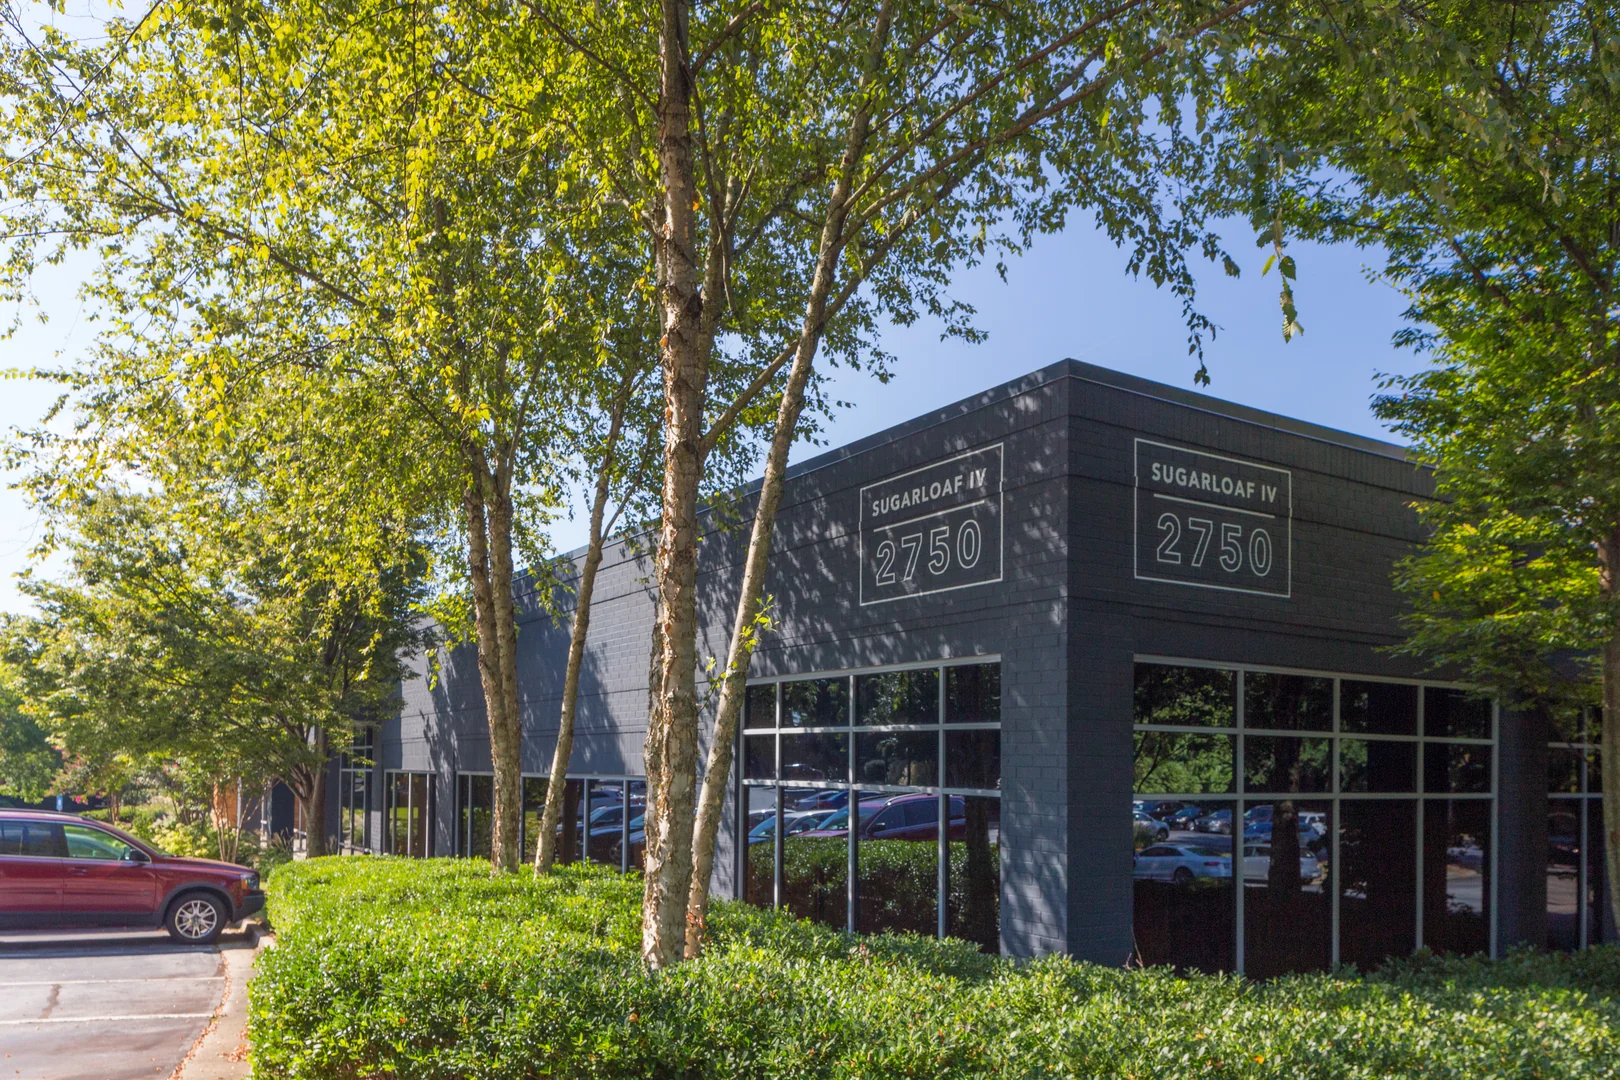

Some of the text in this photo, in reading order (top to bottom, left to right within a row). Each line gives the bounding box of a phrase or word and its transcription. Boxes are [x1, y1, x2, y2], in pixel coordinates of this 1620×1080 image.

[872, 468, 987, 517] SUGARLOAF IV
[1151, 462, 1277, 503] SUGARLOAF IV
[876, 519, 981, 586] 2750
[1157, 512, 1272, 577] 2750
